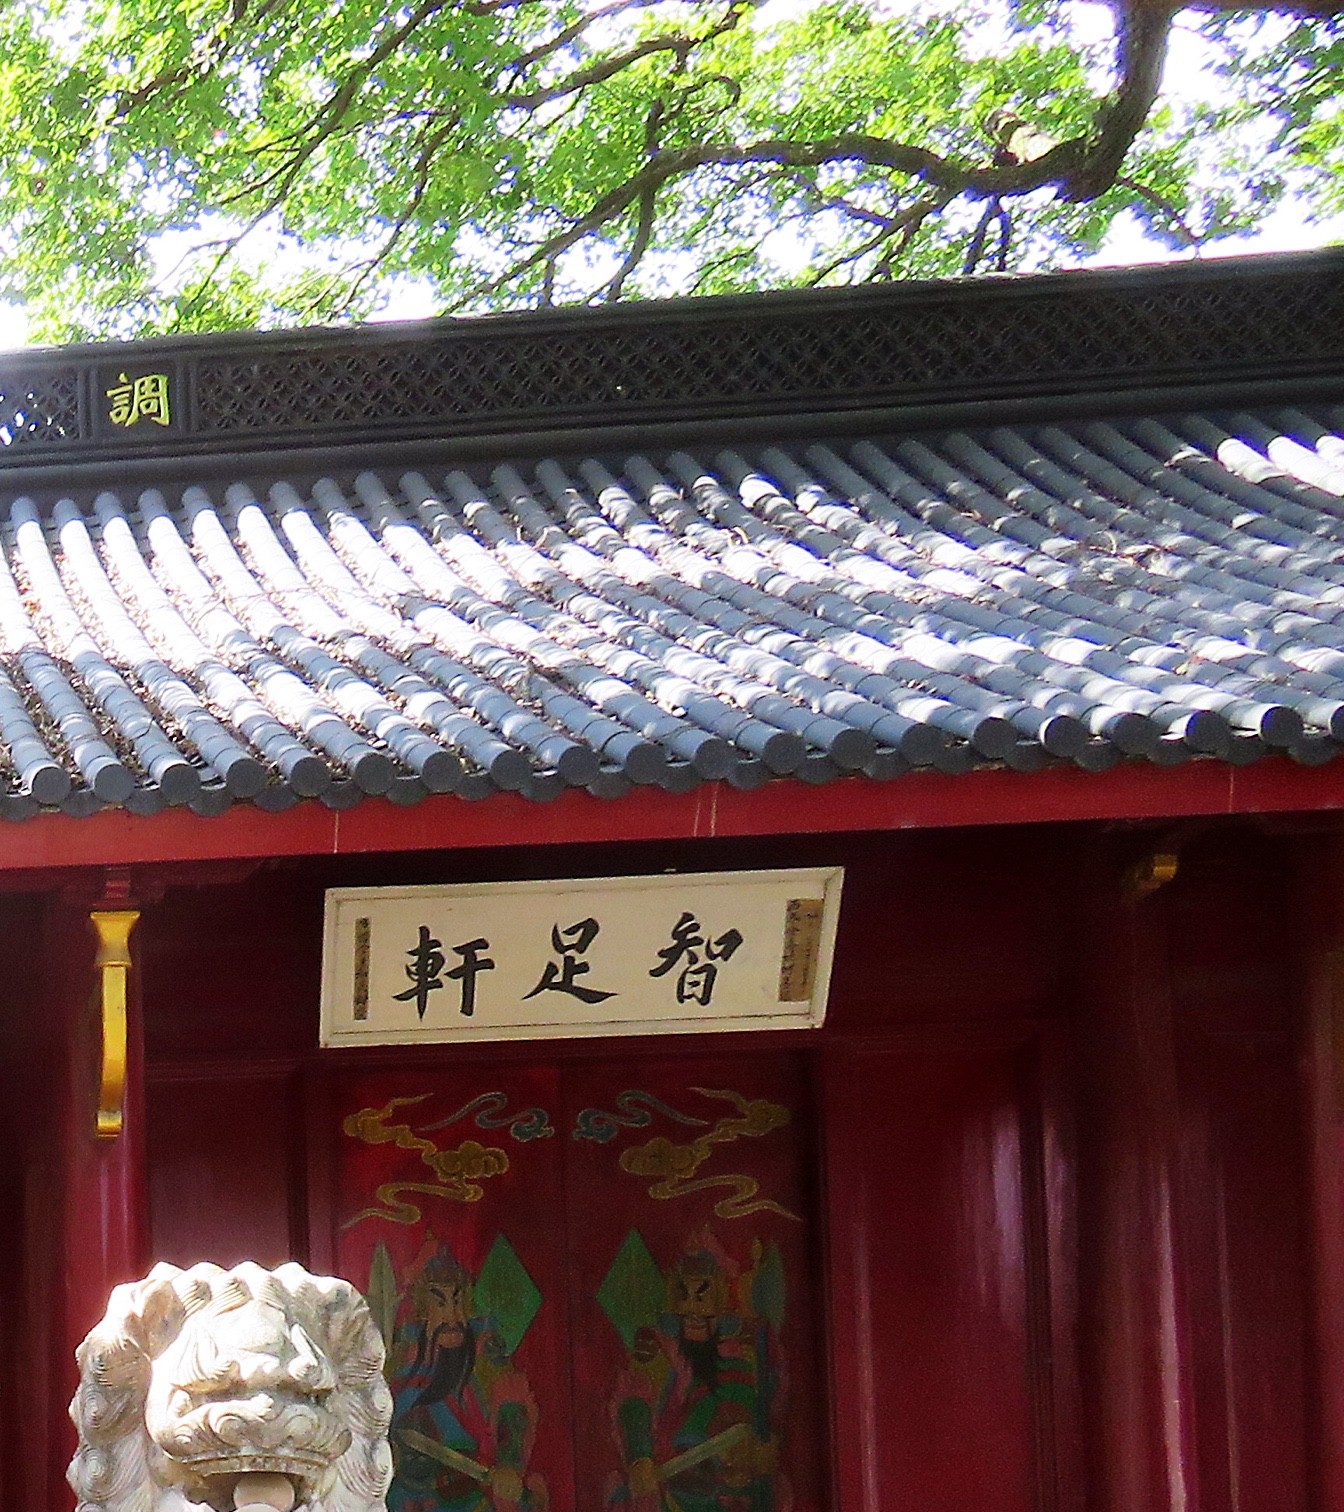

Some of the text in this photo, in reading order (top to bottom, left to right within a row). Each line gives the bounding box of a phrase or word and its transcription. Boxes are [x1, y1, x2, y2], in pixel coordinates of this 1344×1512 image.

[106, 372, 170, 427] 調
[392, 912, 744, 1020] 智足軒
